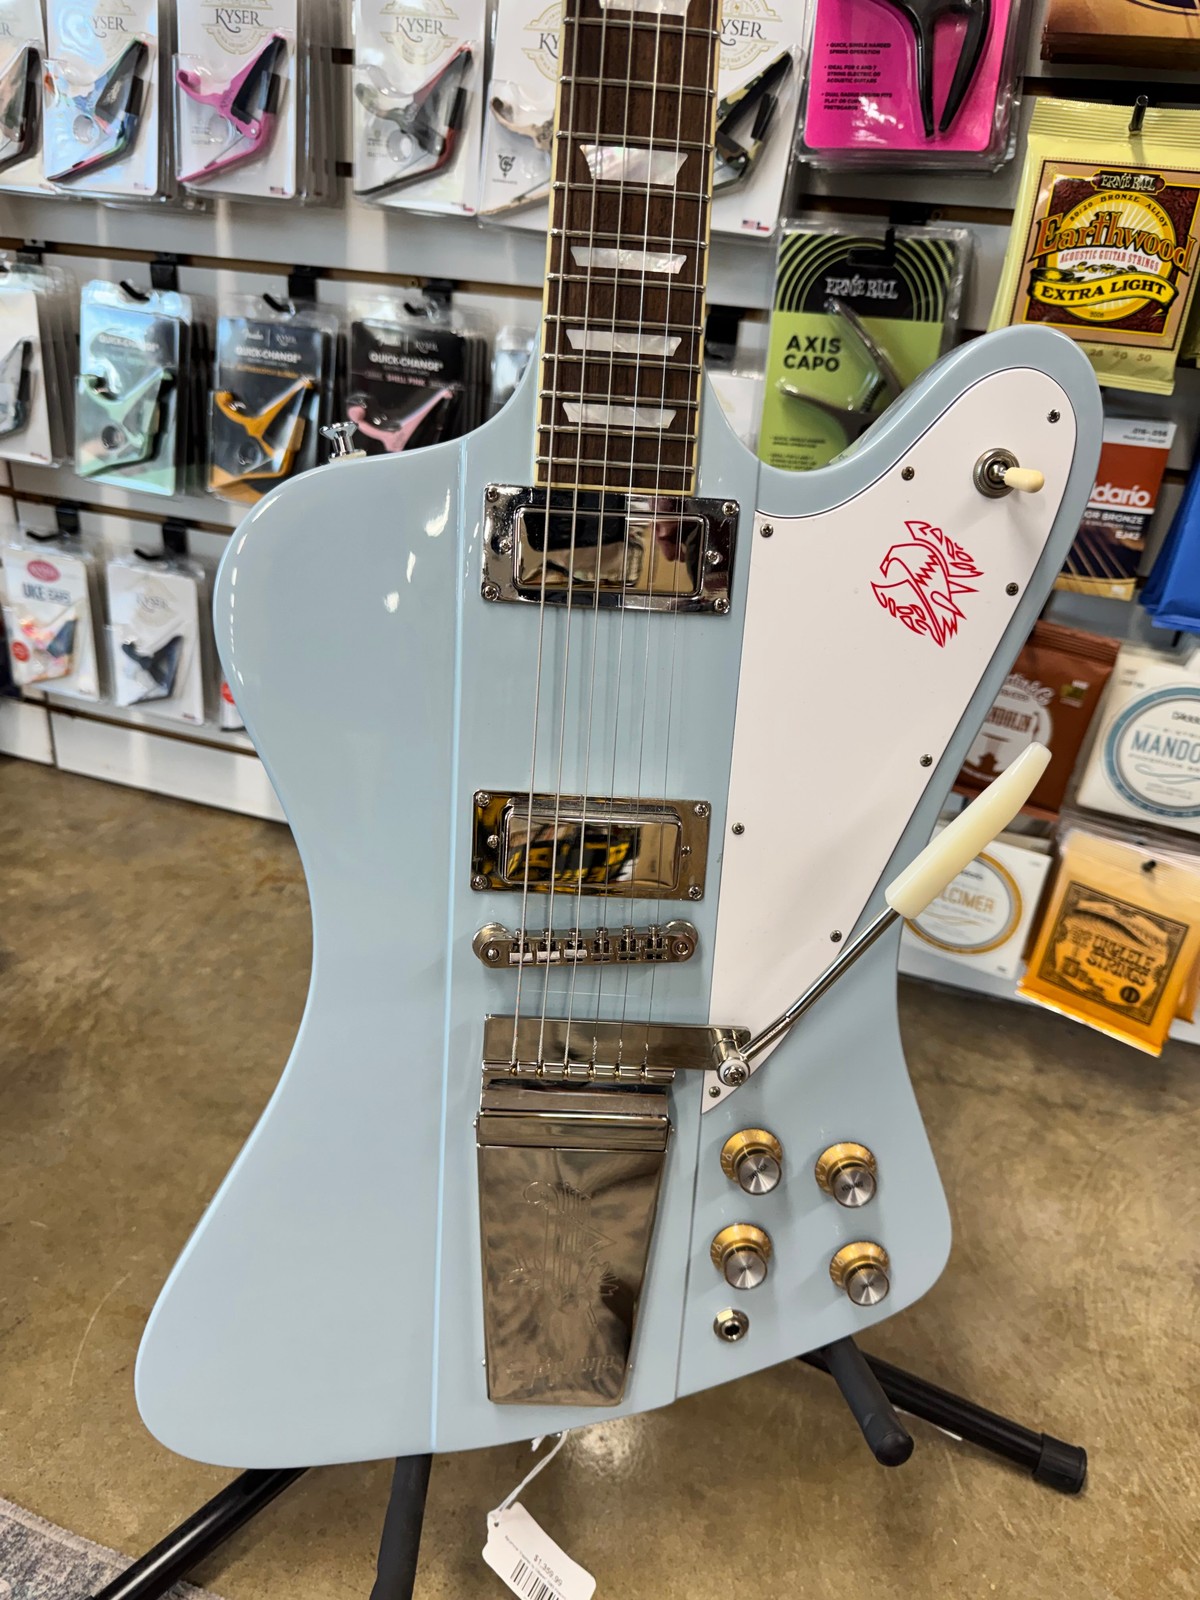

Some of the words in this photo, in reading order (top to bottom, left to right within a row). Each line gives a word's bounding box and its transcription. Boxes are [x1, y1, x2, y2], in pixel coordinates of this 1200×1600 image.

[91, 15, 128, 38] YSER
[215, 8, 264, 33] KYSER
[395, 16, 448, 43] KYSER
[720, 18, 767, 46] YSER
[539, 33, 560, 59] KY
[1101, 173, 1131, 189] ERNIE
[1131, 175, 1156, 191] BALL
[1070, 202, 1094, 222] 80/20
[1100, 193, 1141, 203] BRONZE
[1145, 203, 1169, 228] ALLOY
[1028, 211, 1197, 276] Earthwood
[1060, 250, 1097, 264] ACOUSTIC
[1098, 250, 1127, 262] GUITAR
[1128, 253, 1160, 272] STRINGS
[825, 273, 866, 297] ERNIE
[1041, 285, 1105, 301] EXTRA
[1109, 279, 1167, 296] LIGHT
[786, 335, 841, 354] AXIS
[784, 354, 840, 372] CAPO
[1102, 511, 1144, 525] BRONZE
[1131, 729, 1200, 765] MANDO
[940, 886, 995, 914] LCIMER
